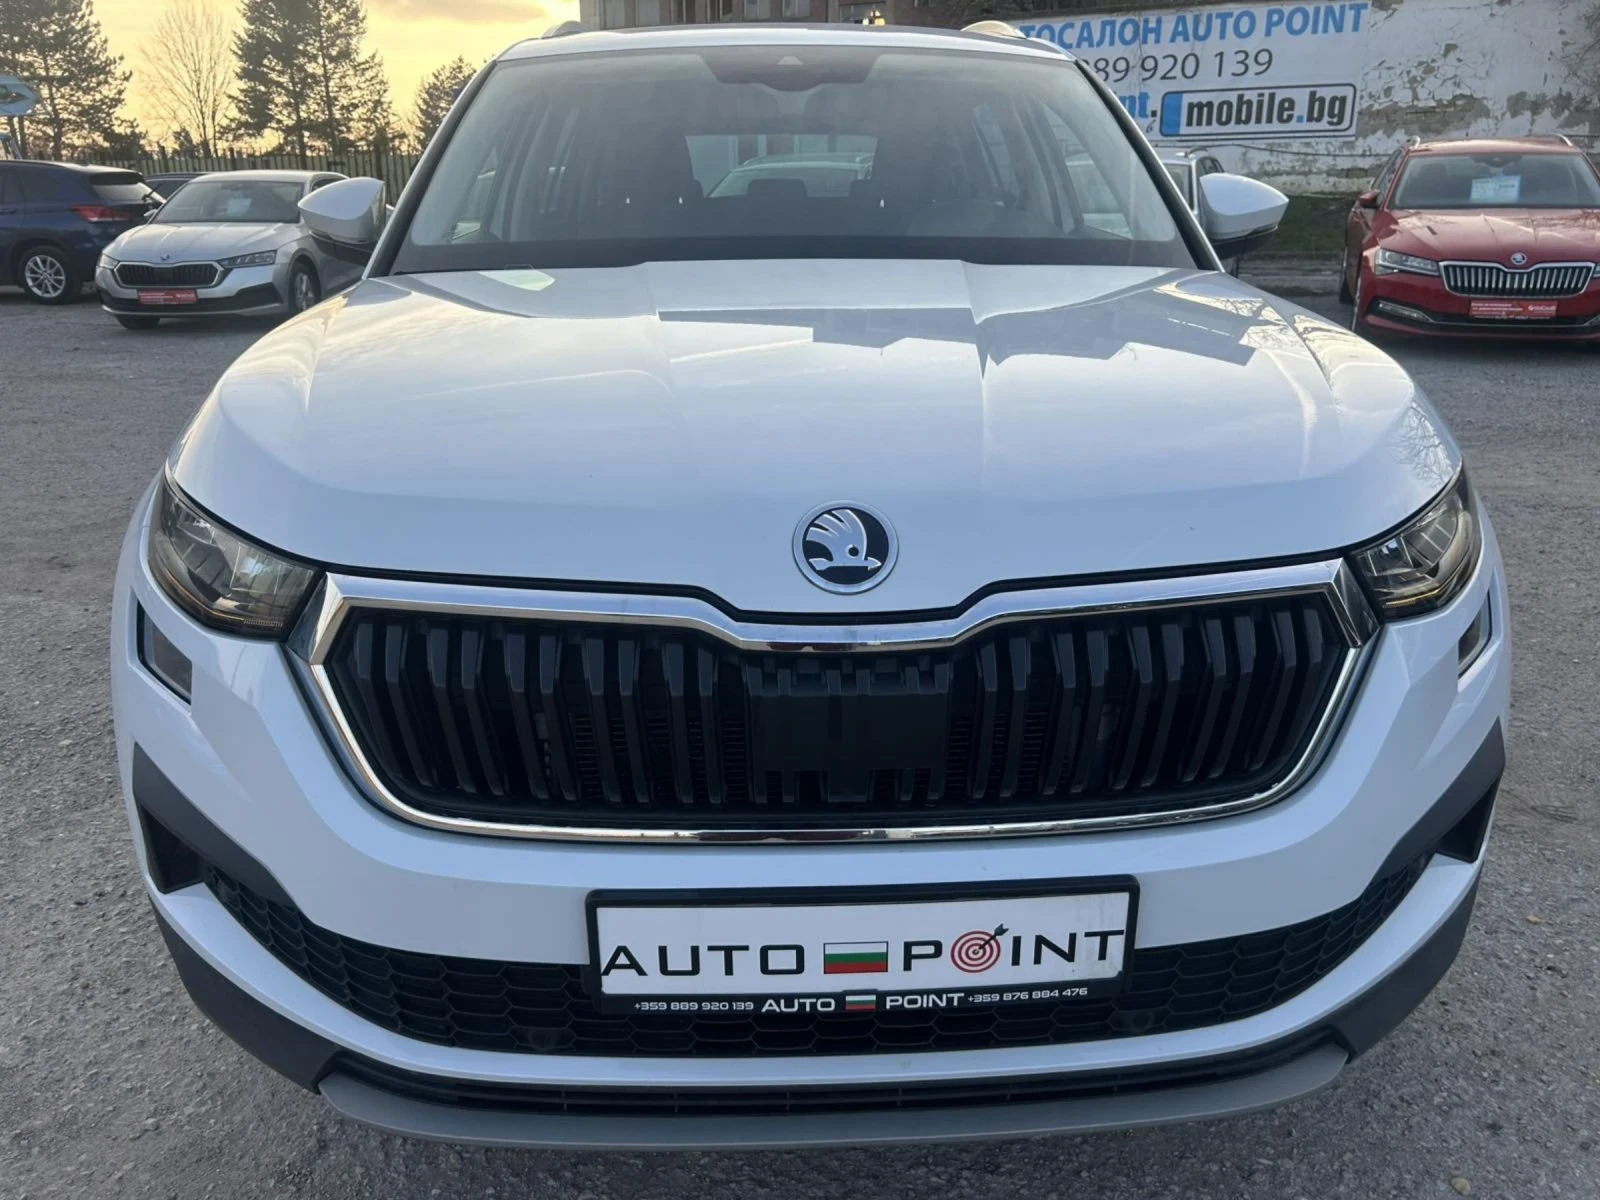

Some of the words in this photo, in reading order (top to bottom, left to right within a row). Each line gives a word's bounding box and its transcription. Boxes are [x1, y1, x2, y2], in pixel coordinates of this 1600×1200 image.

[1169, 10, 1257, 43] AUTO
[1264, 3, 1369, 37] POINT
[1080, 56, 1130, 83] 89
[1141, 53, 1200, 81] 920
[1214, 49, 1273, 77] 139
[1185, 90, 1348, 127] mobile.bg
[601, 945, 805, 976] AUTO
[634, 1001, 667, 1011] +359
[670, 1001, 699, 1011] 889
[701, 1001, 729, 1011] 920
[732, 1001, 754, 1011] 139
[761, 998, 836, 1012] AUTO
[886, 993, 965, 1009] POINT
[968, 993, 1000, 1003] +359
[1003, 991, 1029, 1001] 876
[1032, 989, 1059, 998] 884
[1062, 987, 1088, 997] 476
